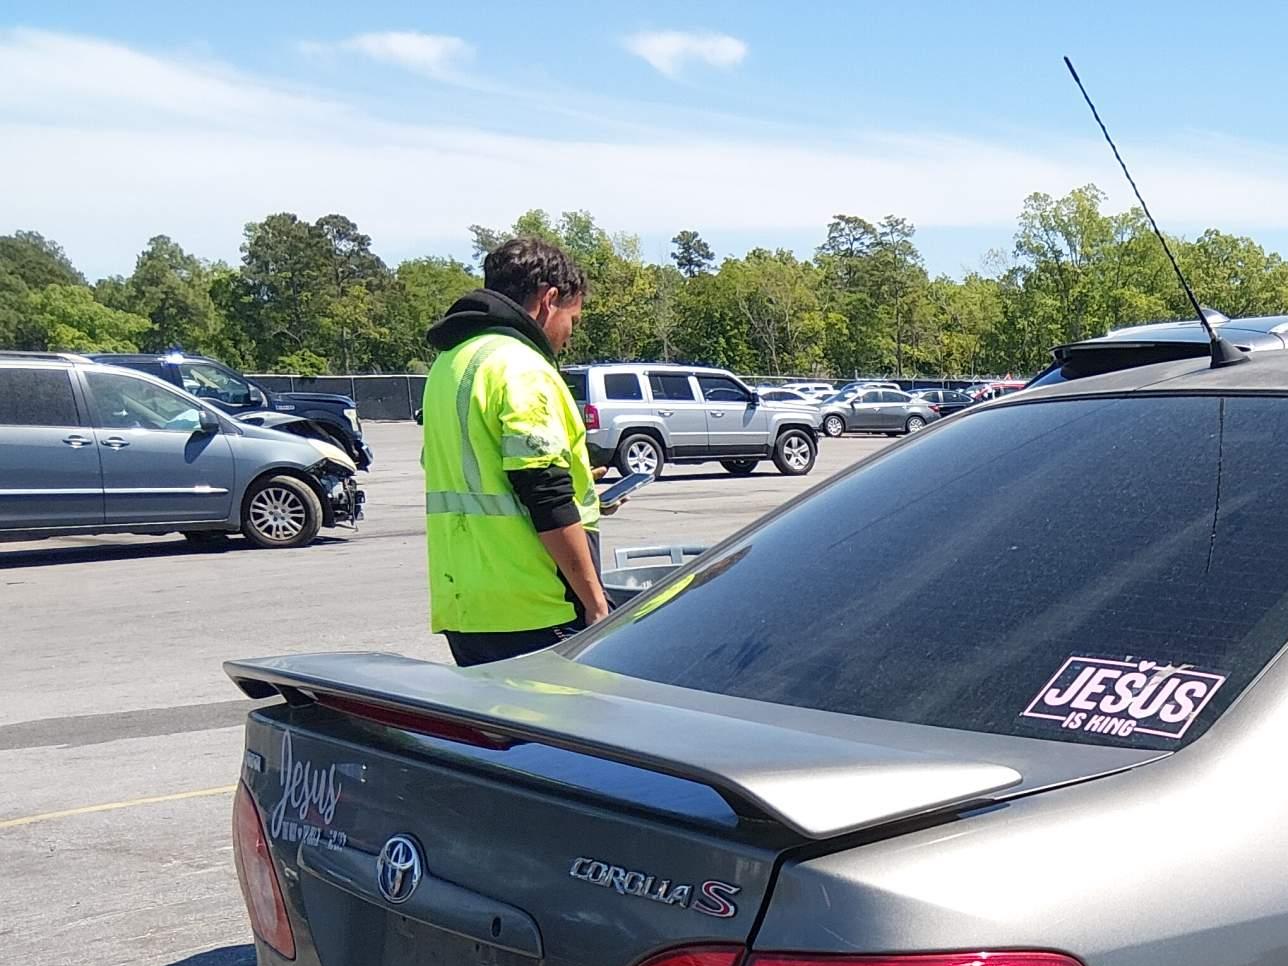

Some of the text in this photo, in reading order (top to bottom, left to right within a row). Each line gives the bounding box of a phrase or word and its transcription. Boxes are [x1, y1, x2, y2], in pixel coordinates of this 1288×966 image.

[1044, 666, 1208, 723] JESUS
[1062, 711, 1137, 737] IS KING
[271, 729, 342, 838] Jesus
[570, 857, 741, 918] COROLLA S
